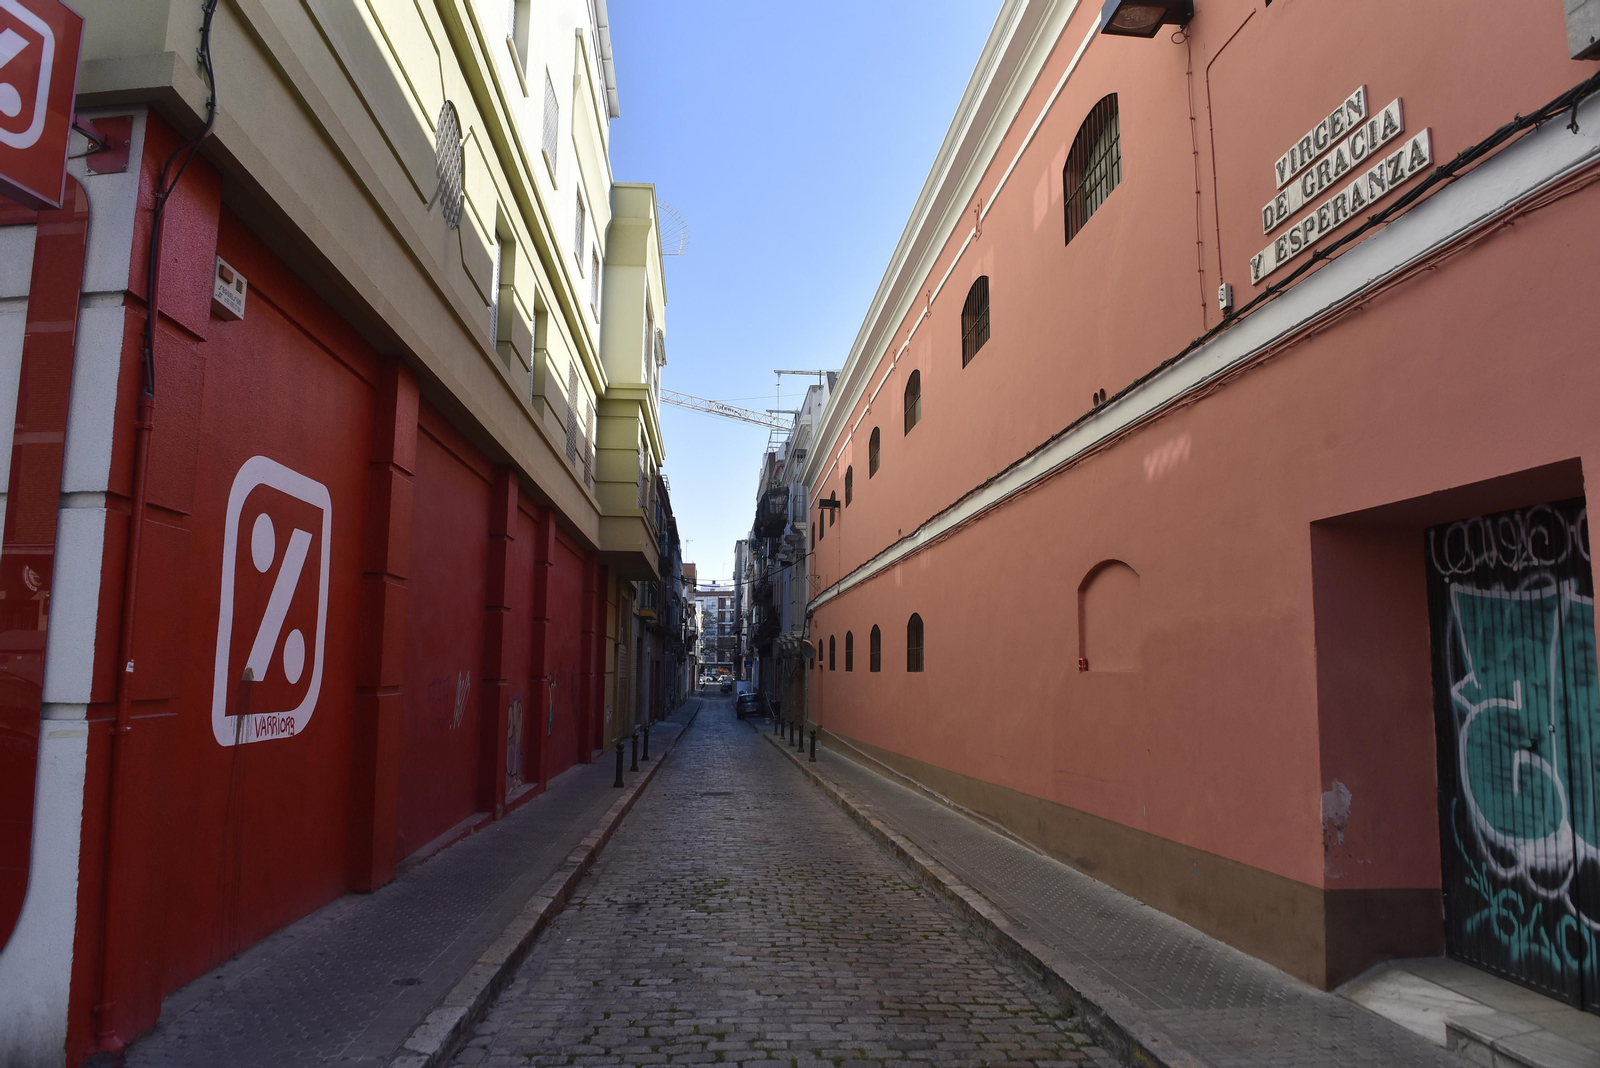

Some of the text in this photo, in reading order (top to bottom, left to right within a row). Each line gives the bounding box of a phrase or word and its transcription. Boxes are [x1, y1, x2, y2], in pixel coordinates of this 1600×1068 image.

[1262, 107, 1399, 231] DE GRACIA
[1275, 90, 1363, 183] VIRGEN
[1250, 138, 1428, 279] Y ESPERANZA
